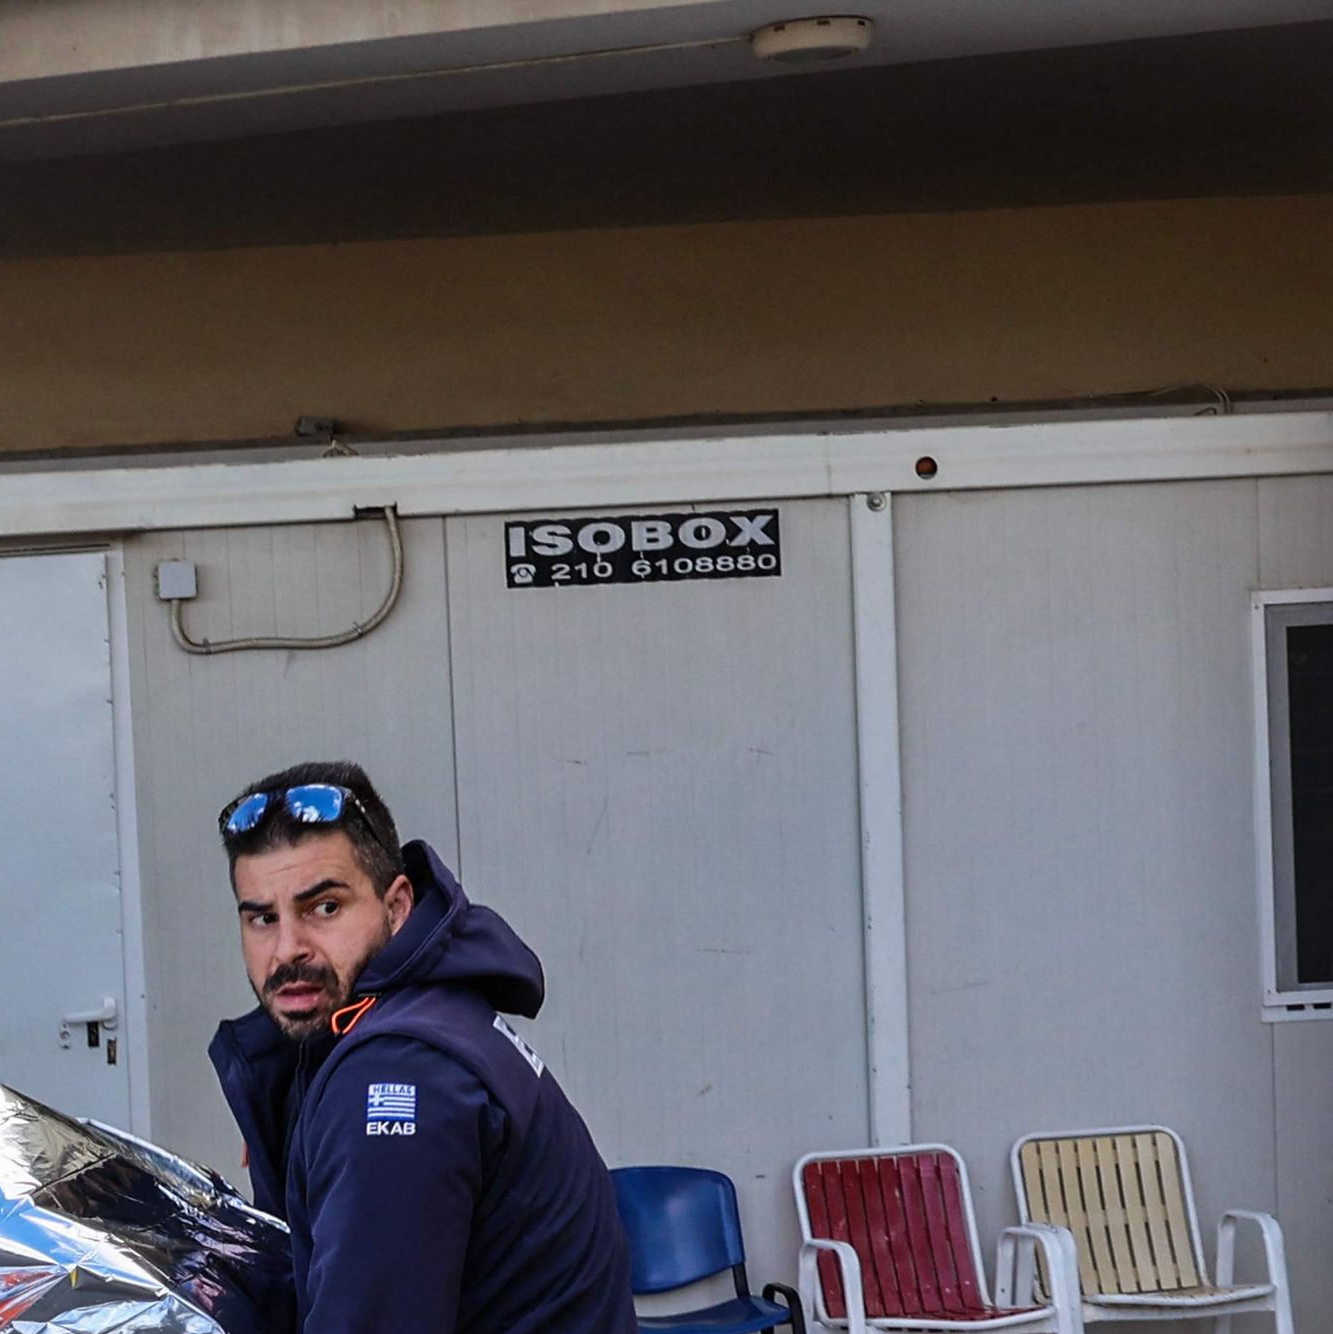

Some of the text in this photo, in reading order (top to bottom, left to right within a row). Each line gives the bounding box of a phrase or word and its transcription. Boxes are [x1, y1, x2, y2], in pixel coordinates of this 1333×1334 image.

[509, 515, 776, 557] ISOBOX
[551, 553, 777, 581] 210 6108880
